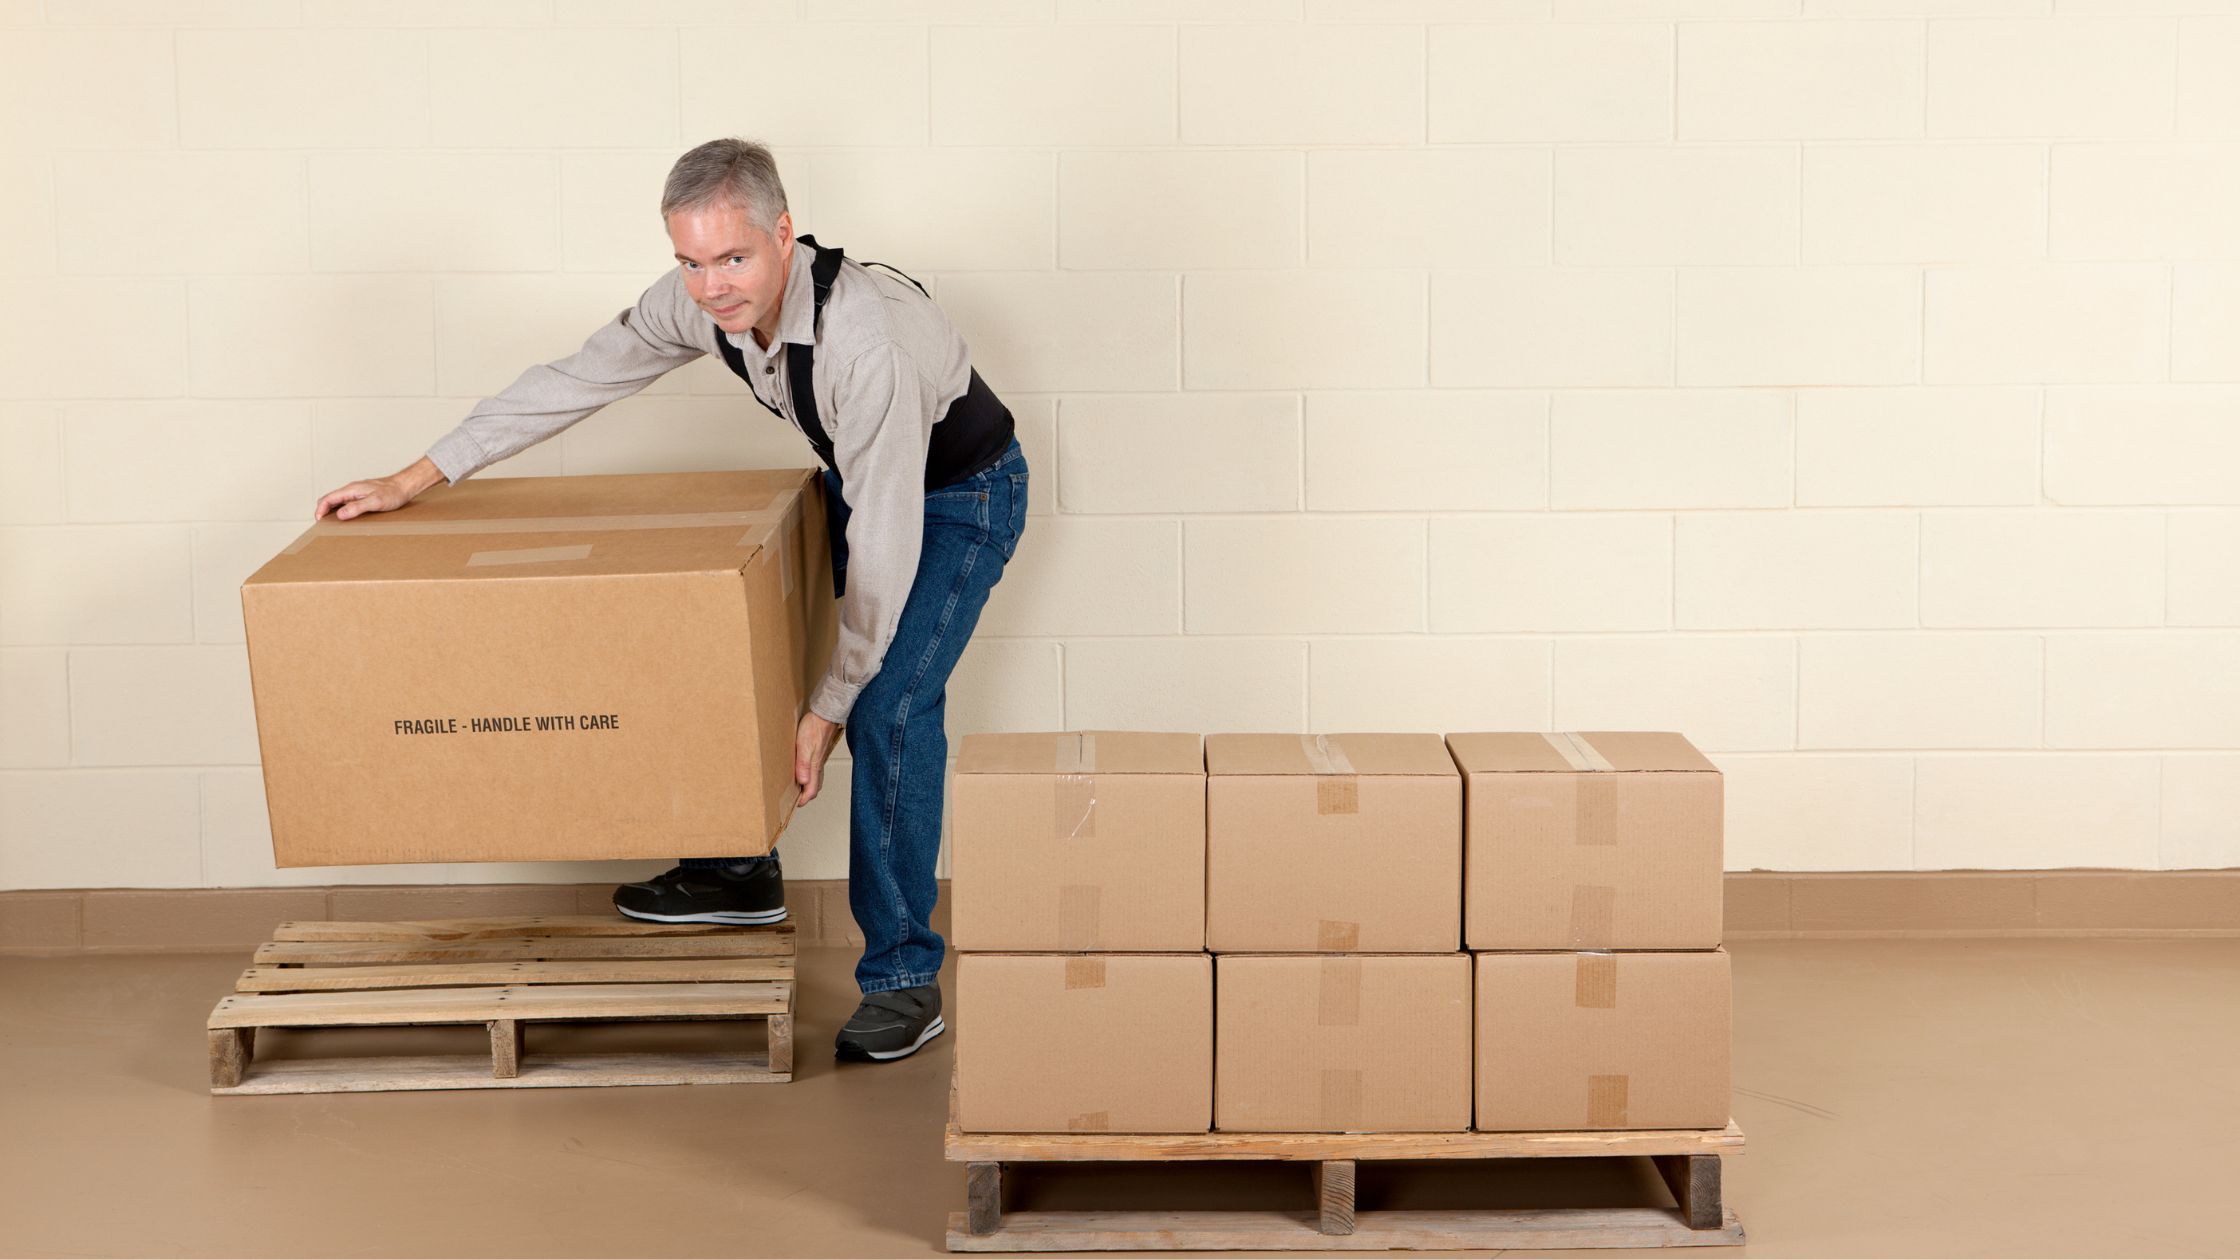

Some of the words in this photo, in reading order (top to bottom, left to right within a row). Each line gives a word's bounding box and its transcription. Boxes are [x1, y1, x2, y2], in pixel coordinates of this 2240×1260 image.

[394, 719, 458, 735] FRAGILE
[471, 716, 532, 733] HANDLE
[535, 715, 575, 731] WITH
[579, 714, 620, 730] CARE
